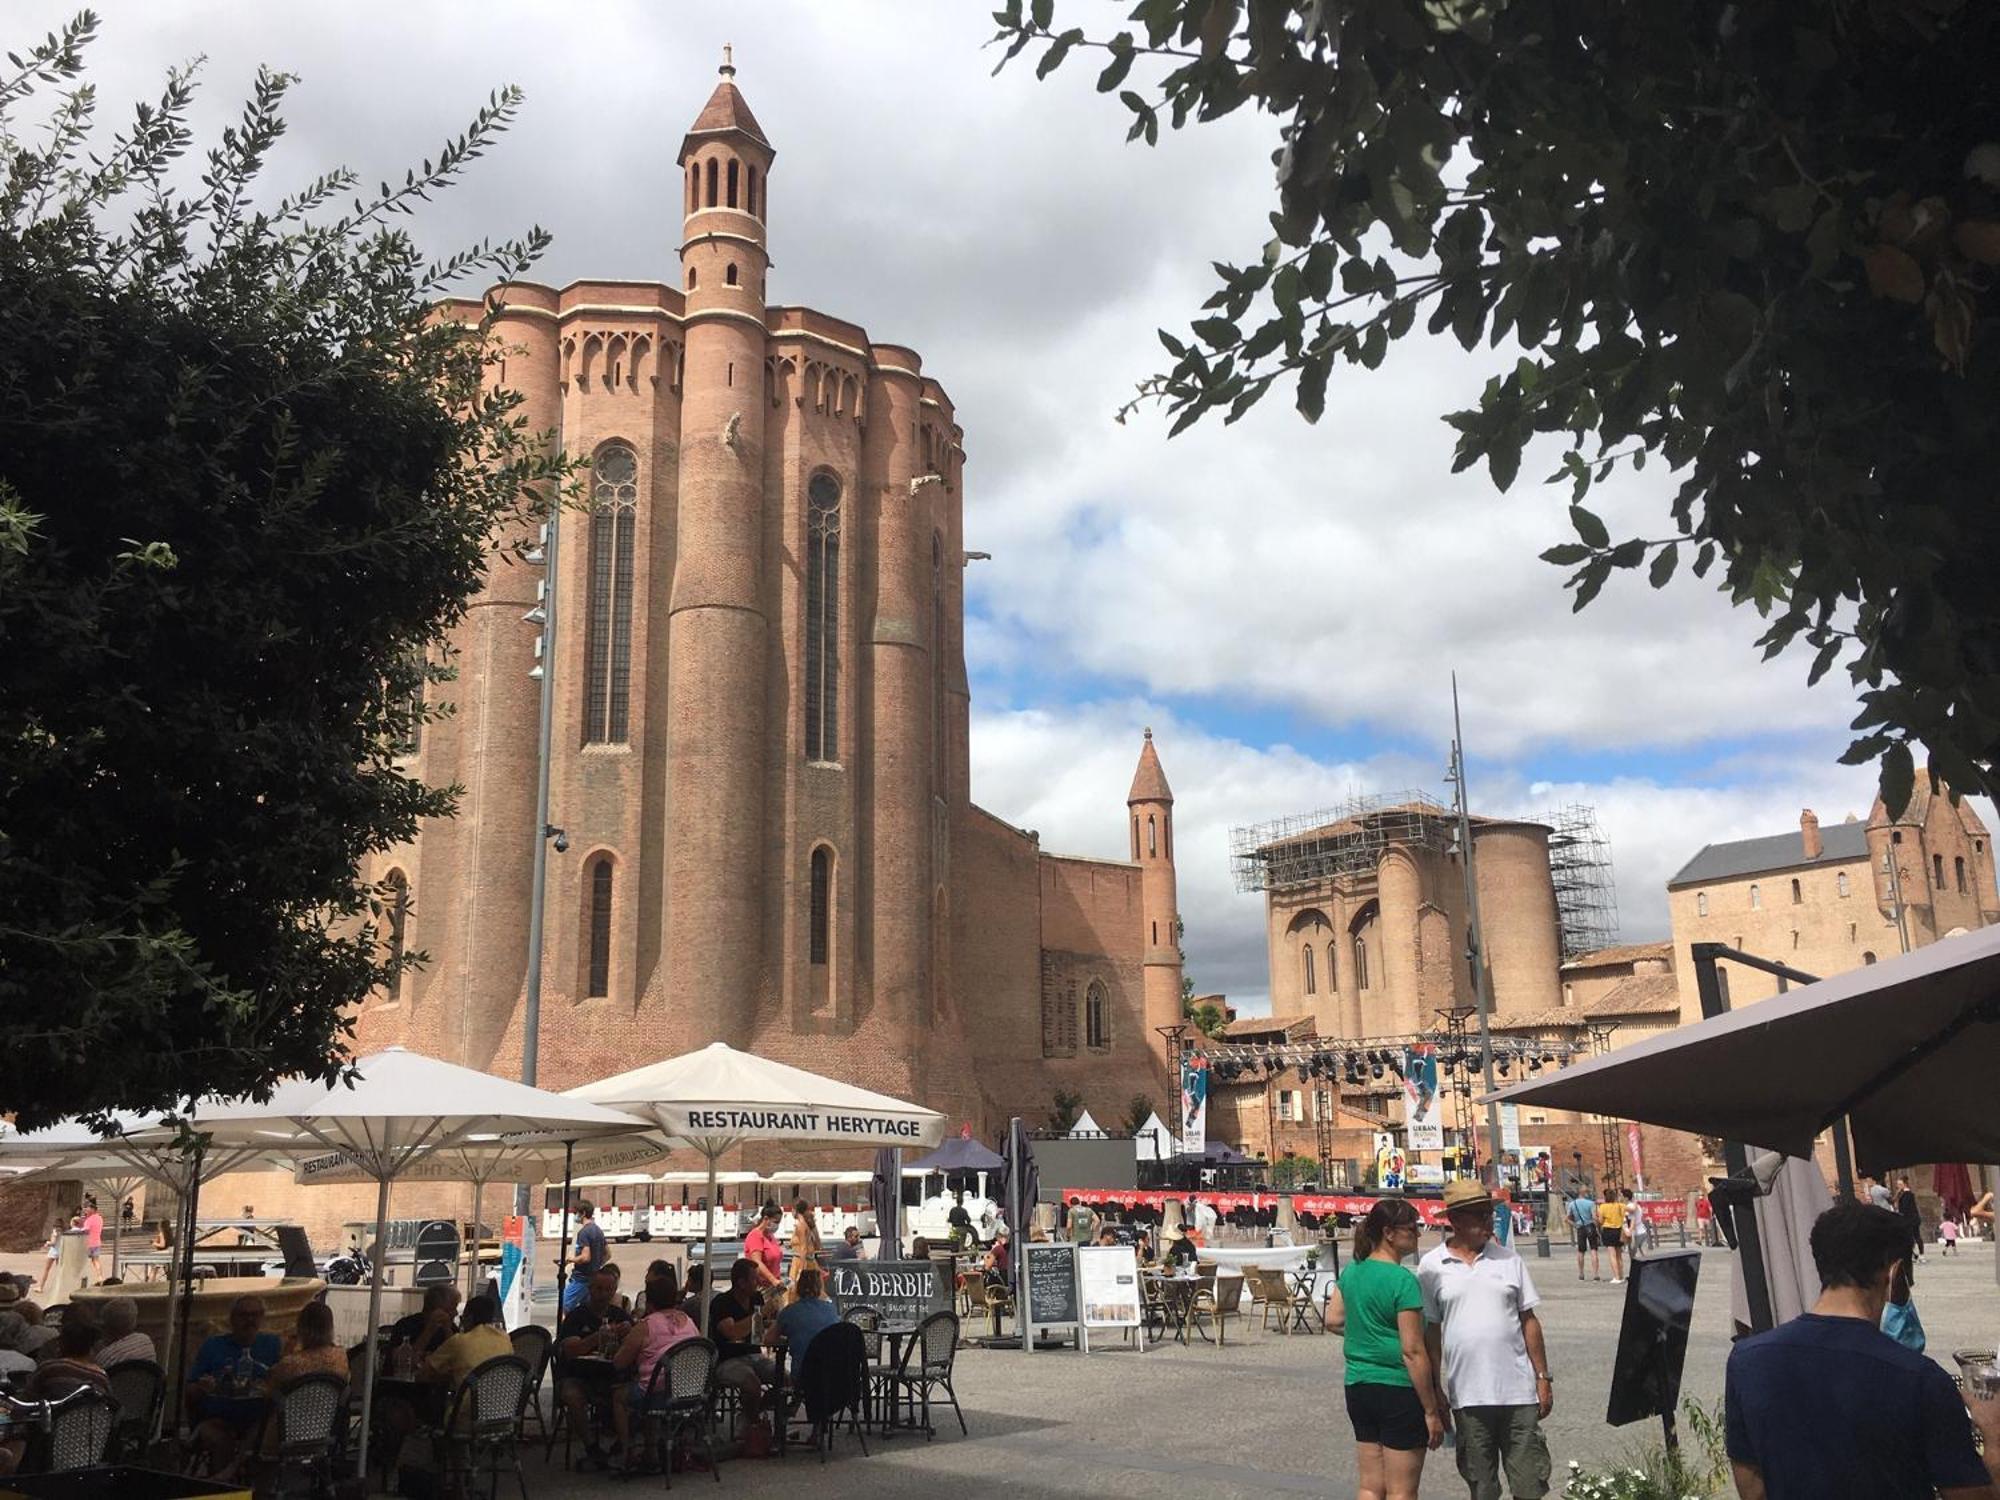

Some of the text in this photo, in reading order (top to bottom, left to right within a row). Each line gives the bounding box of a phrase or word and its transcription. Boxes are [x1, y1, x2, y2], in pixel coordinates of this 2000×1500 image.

[688, 1110, 921, 1137] RESTAURANT HERYTAGE
[838, 1271, 934, 1298] LA BERBIE
